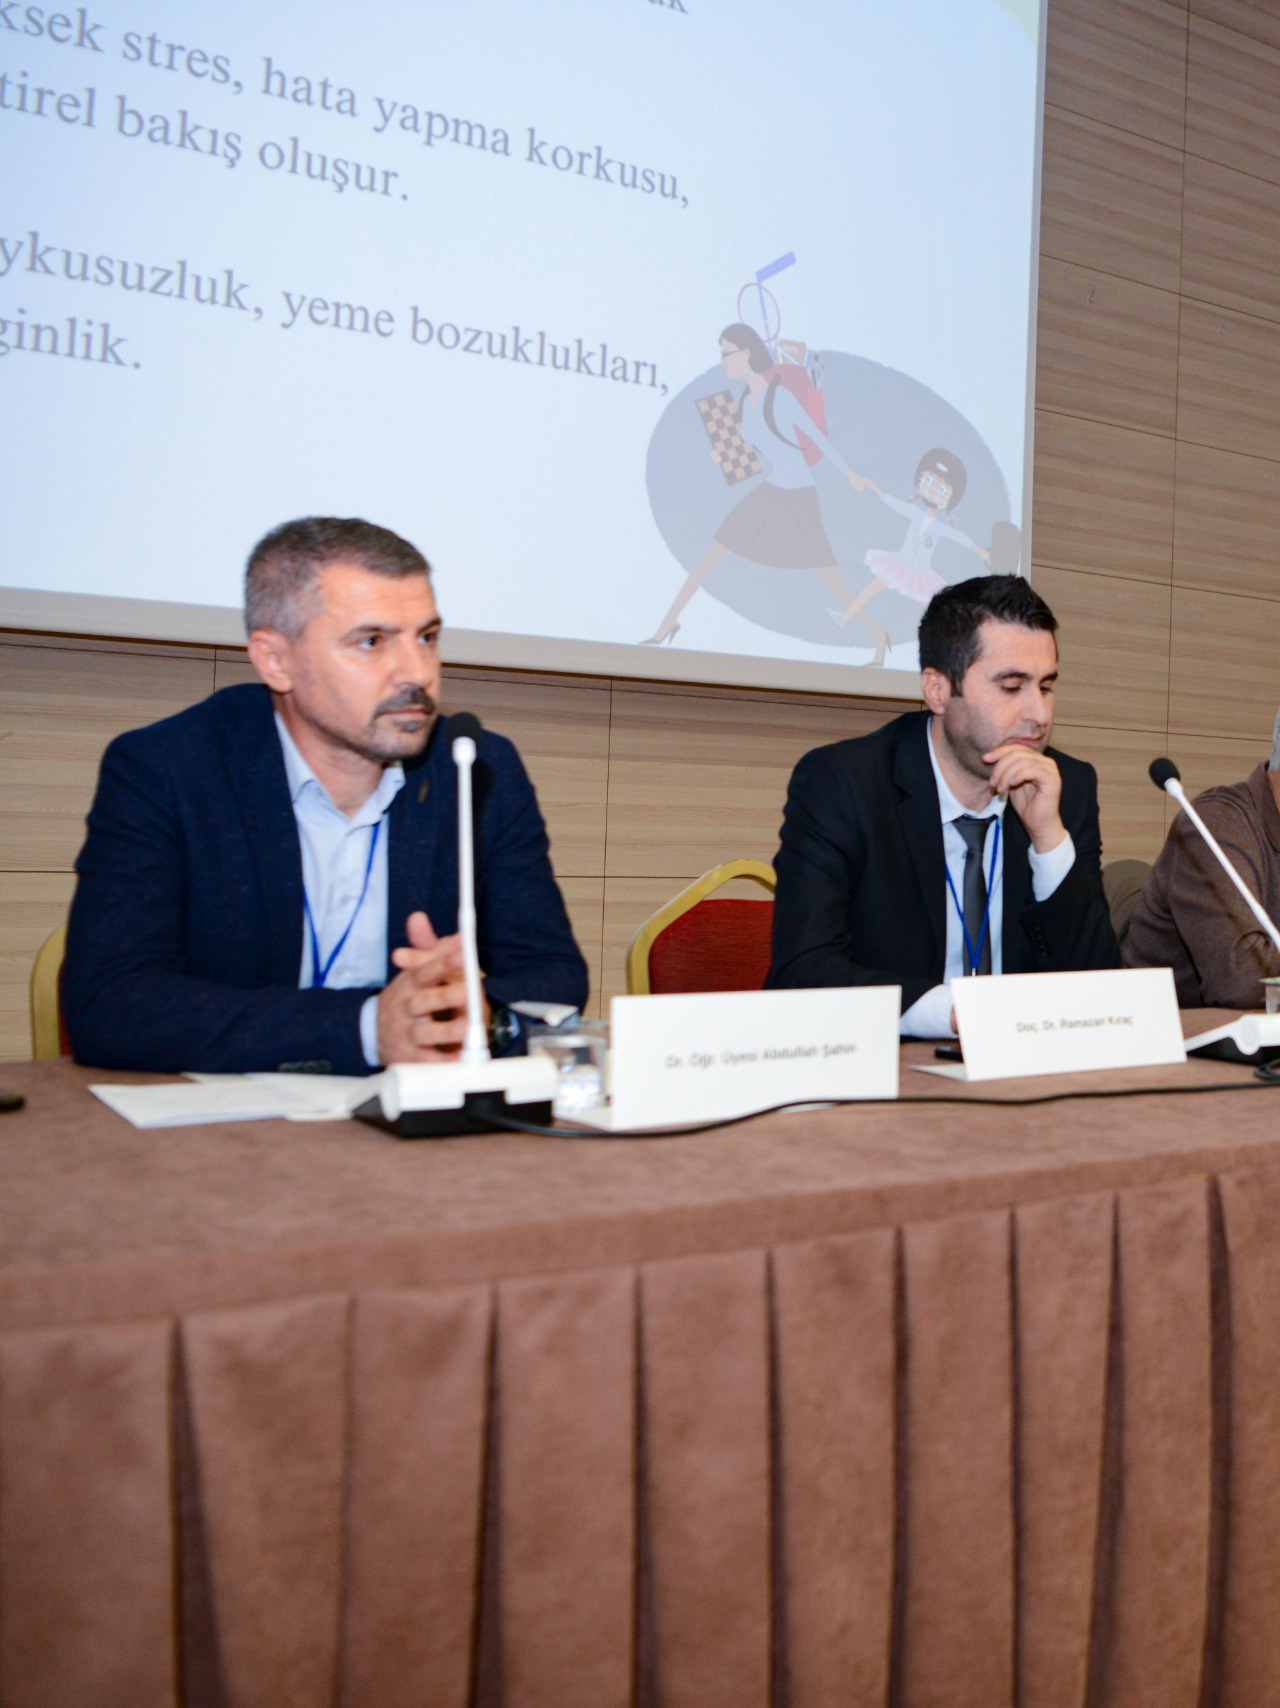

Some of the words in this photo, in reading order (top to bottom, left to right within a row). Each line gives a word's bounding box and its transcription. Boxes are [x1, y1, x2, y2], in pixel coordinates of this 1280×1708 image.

[115, 95, 243, 169] bakış
[258, 136, 409, 201] oluşur.
[122, 31, 244, 95] stres,
[261, 57, 359, 118] hata
[373, 96, 511, 157] yapma
[525, 127, 689, 209] korkusu,
[0, 230, 264, 321] ykusuzluk,
[280, 291, 395, 338] yeme
[410, 306, 669, 397] bozuklukları,
